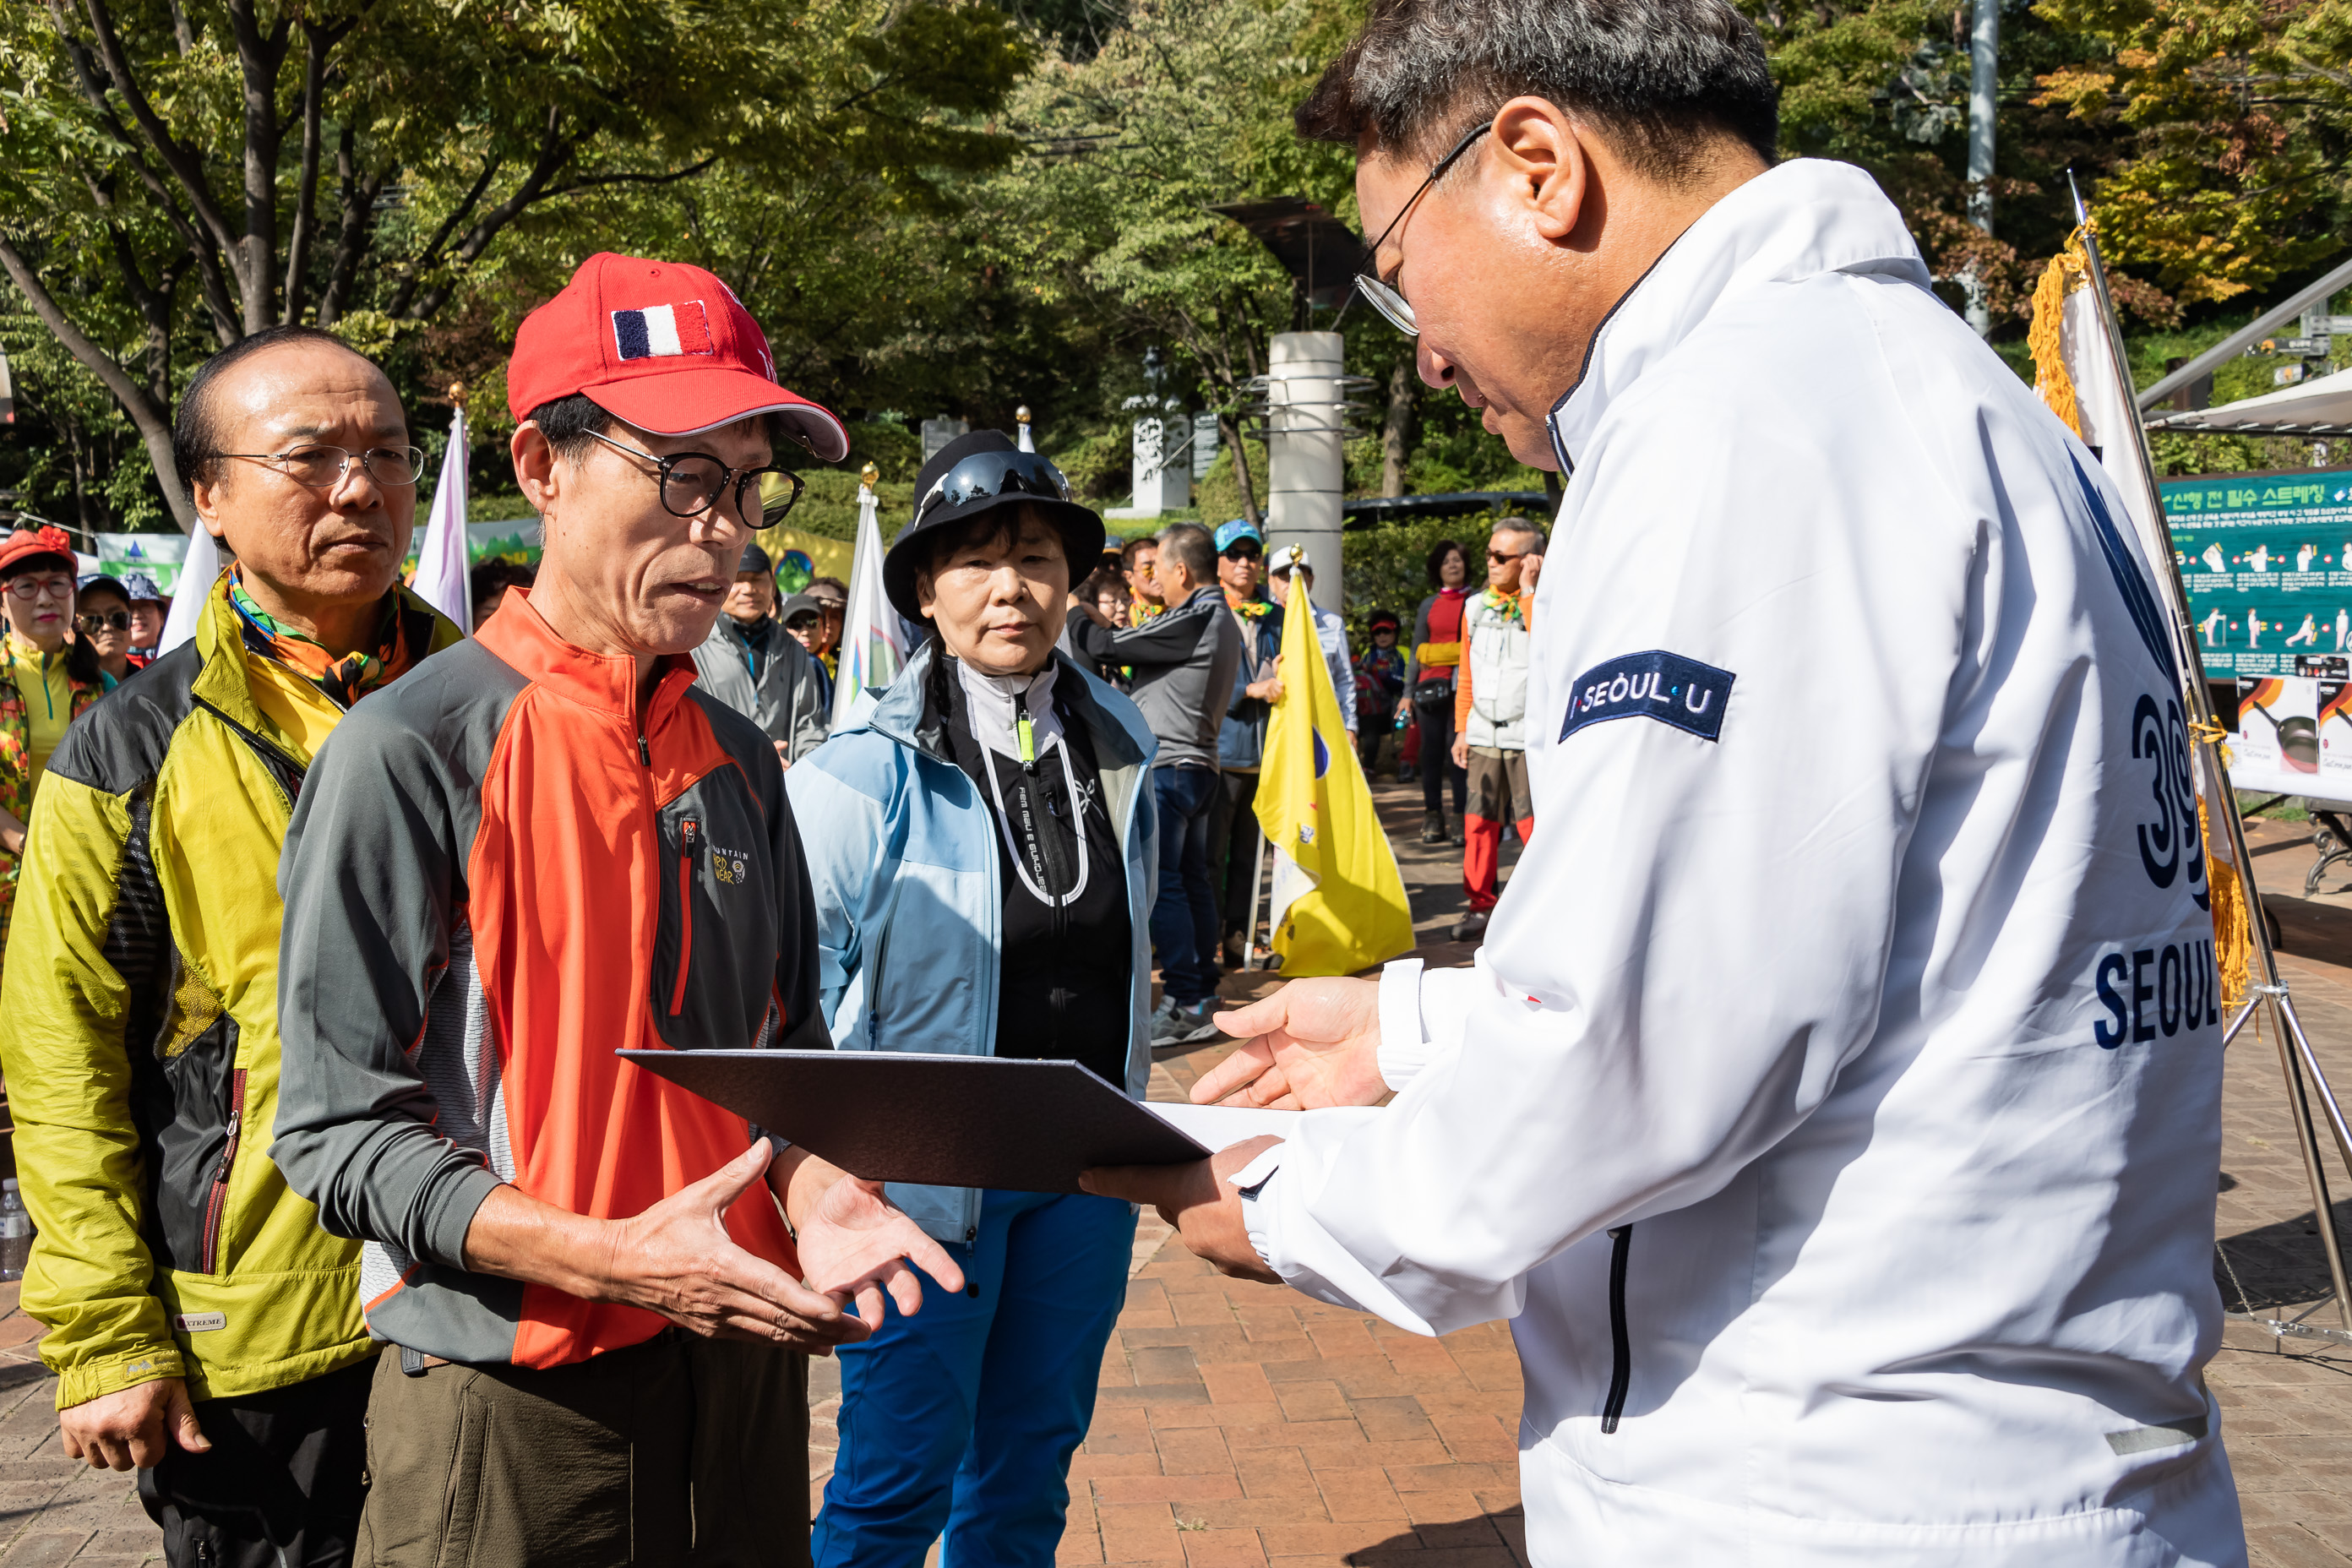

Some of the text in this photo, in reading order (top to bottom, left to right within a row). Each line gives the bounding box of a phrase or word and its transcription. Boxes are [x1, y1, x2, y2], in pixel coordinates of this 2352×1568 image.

[2172, 491, 2202, 511] 산행
[2206, 490, 2223, 509] 전
[2227, 488, 2257, 508] 필수
[2262, 484, 2325, 506] 스트레칭
[1018, 787, 1028, 808] way
[1021, 810, 1032, 831] new
[1028, 843, 1047, 895] earching
[2093, 939, 2218, 1050] SEOUL
